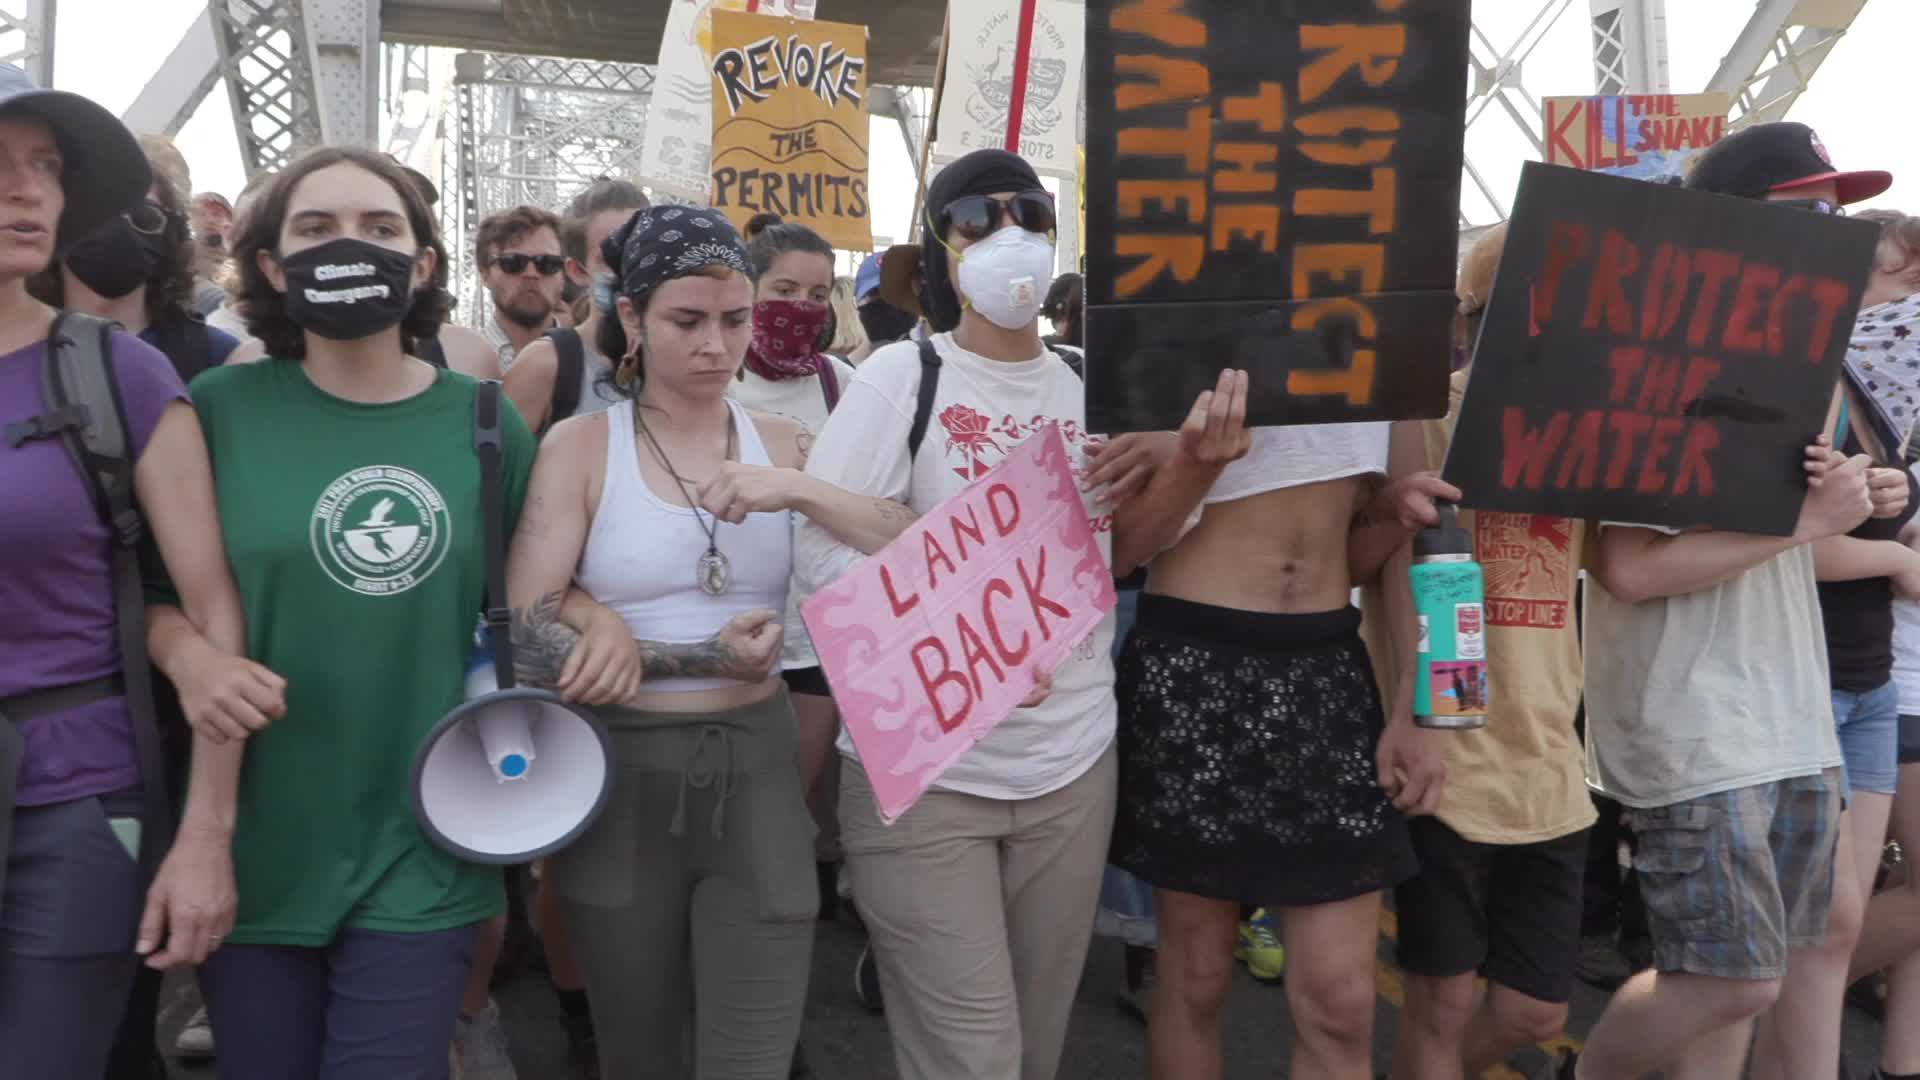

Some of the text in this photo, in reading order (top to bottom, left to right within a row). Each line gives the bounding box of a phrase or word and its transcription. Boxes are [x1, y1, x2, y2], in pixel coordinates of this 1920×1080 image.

[711, 34, 866, 117] REVOKE
[770, 128, 818, 159] THE
[1211, 81, 1285, 254] THE
[1546, 95, 1680, 170] KILL THE
[1633, 116, 1727, 152] SNAKE
[712, 166, 869, 219] PERMITS
[1286, 0, 1406, 406] ROTECT
[1533, 222, 1849, 367] PROTECT
[1502, 405, 1721, 497] WATER
[879, 483, 1020, 619] LAND
[911, 545, 1071, 734] BACK
[1484, 601, 1525, 623] STOP
[1528, 603, 1556, 626] LINE
